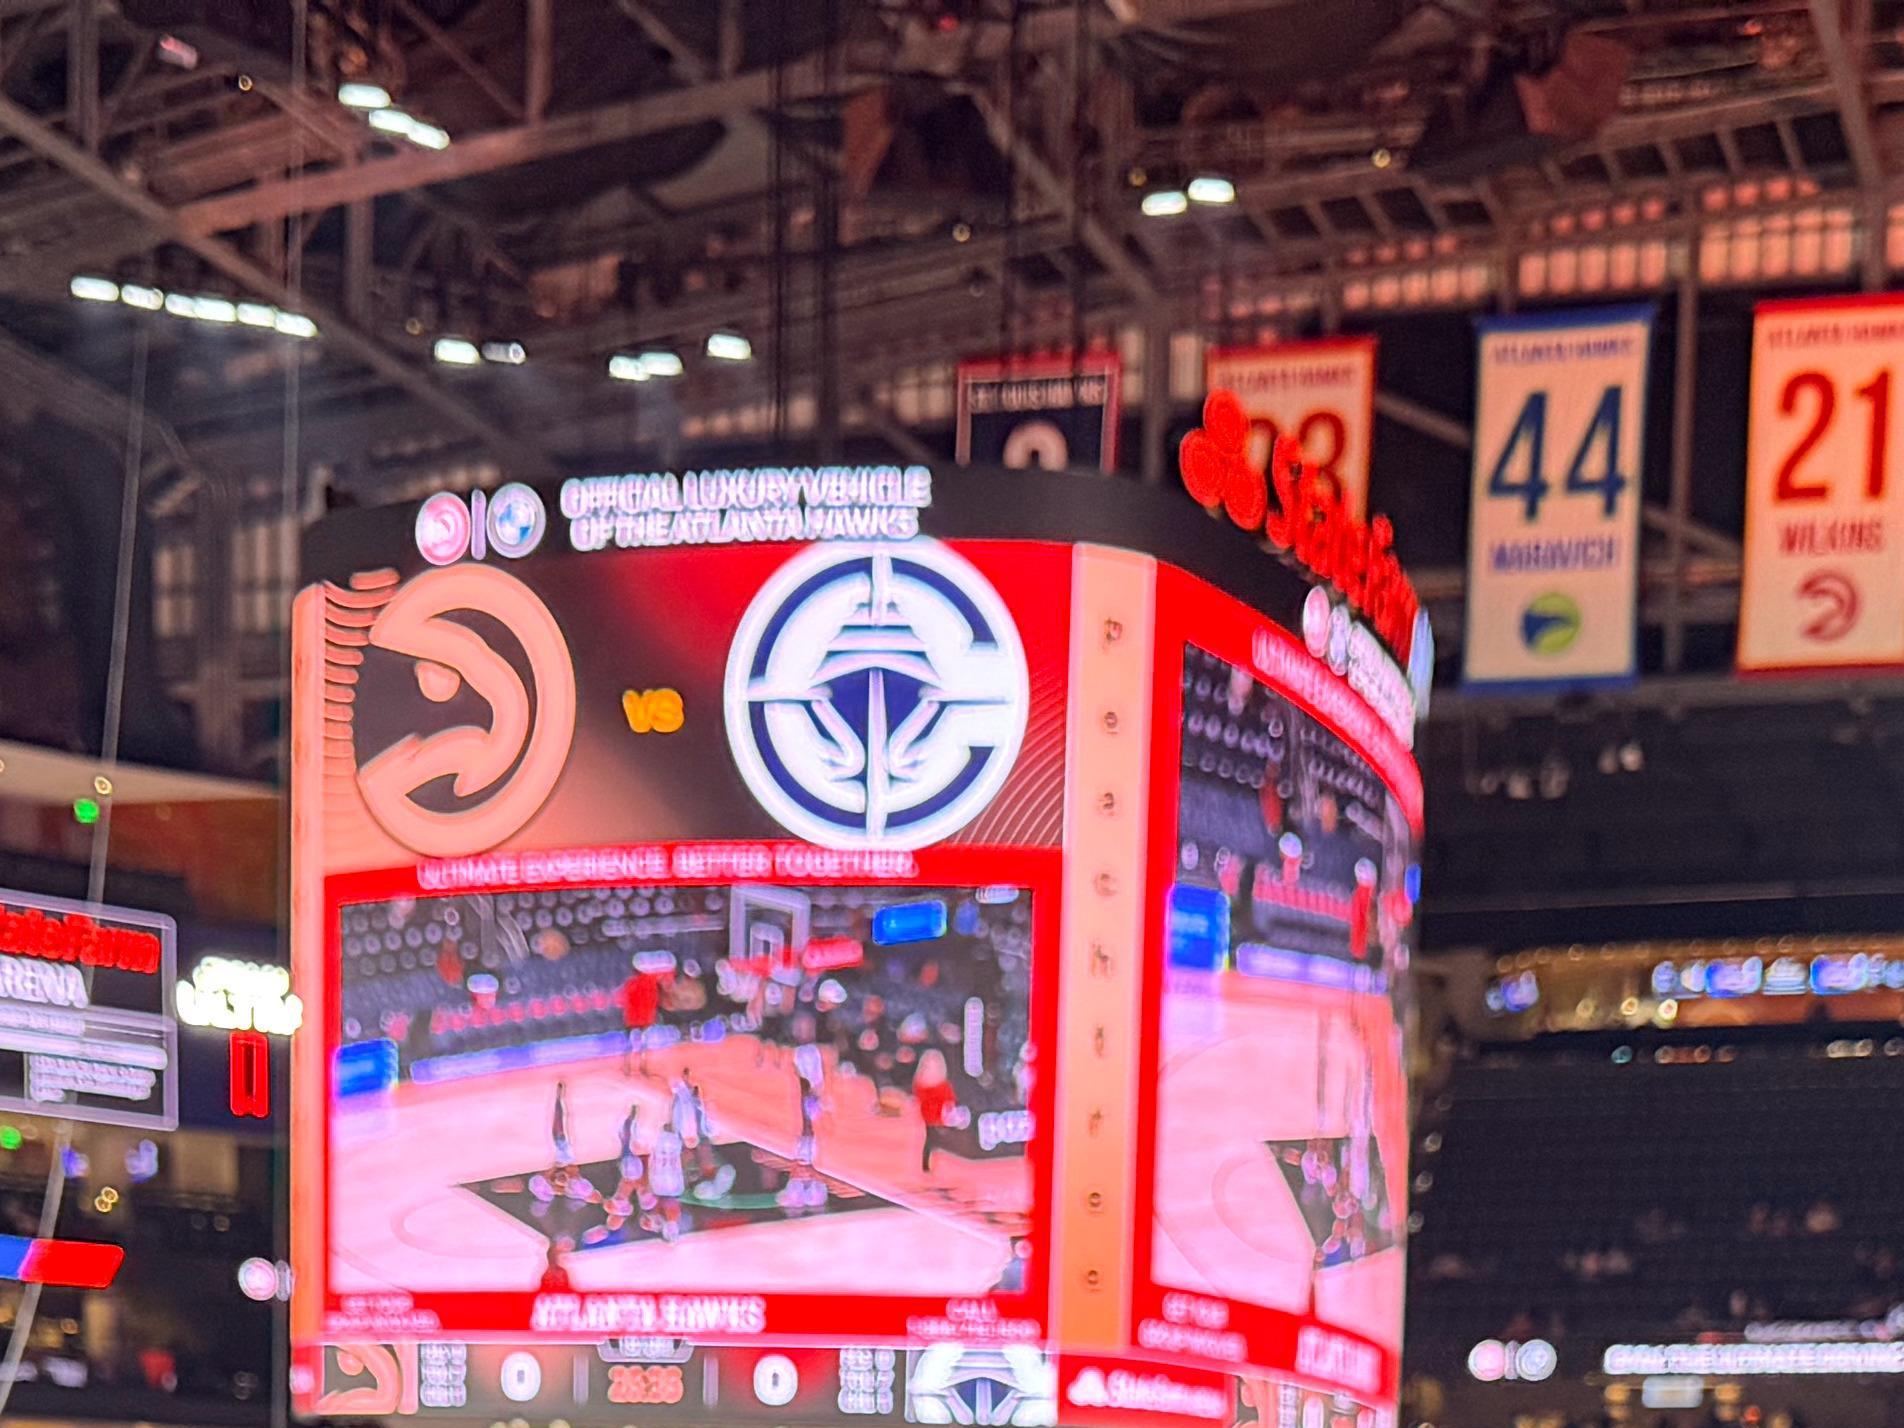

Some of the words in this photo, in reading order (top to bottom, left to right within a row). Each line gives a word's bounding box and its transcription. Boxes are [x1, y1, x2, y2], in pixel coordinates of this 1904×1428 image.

[1488, 384, 1626, 522] 44
[1776, 368, 1892, 502] 21
[1780, 516, 1883, 555] WILKINS
[623, 687, 685, 734] VS
